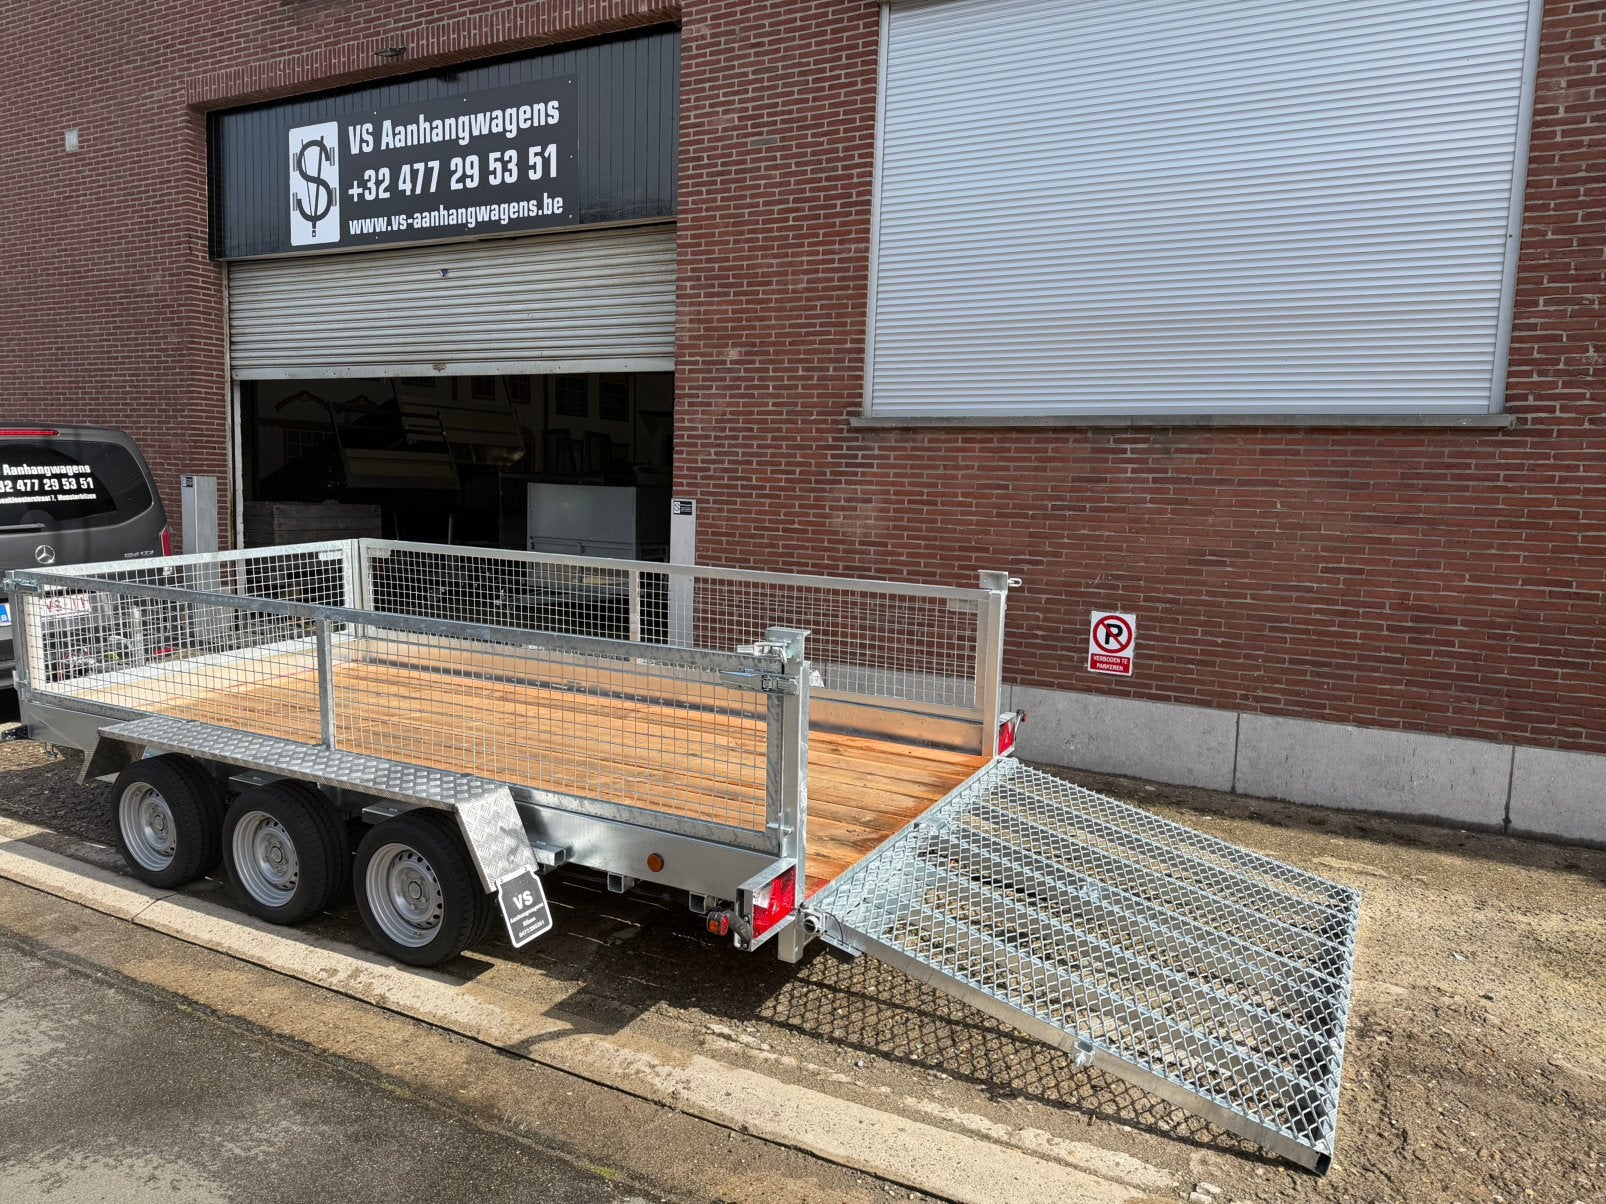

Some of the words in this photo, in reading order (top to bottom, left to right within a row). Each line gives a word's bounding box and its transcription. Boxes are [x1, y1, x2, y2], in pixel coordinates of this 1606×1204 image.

[348, 123, 374, 155] VS
[381, 100, 560, 150] Aanhangwagens
[348, 167, 391, 202] +32
[398, 160, 440, 196] 477
[450, 154, 479, 191] 29
[488, 149, 518, 186] 53
[528, 143, 557, 181] 51
[349, 193, 563, 235] www.vs-aanhangwagens.be
[2, 463, 91, 477] Aanhangwagens
[16, 479, 39, 492] 477
[43, 478, 60, 491] 29
[61, 477, 77, 490] 53
[79, 477, 94, 489] 51
[1096, 663, 1124, 671] PARKEREN
[512, 890, 534, 910] VS
